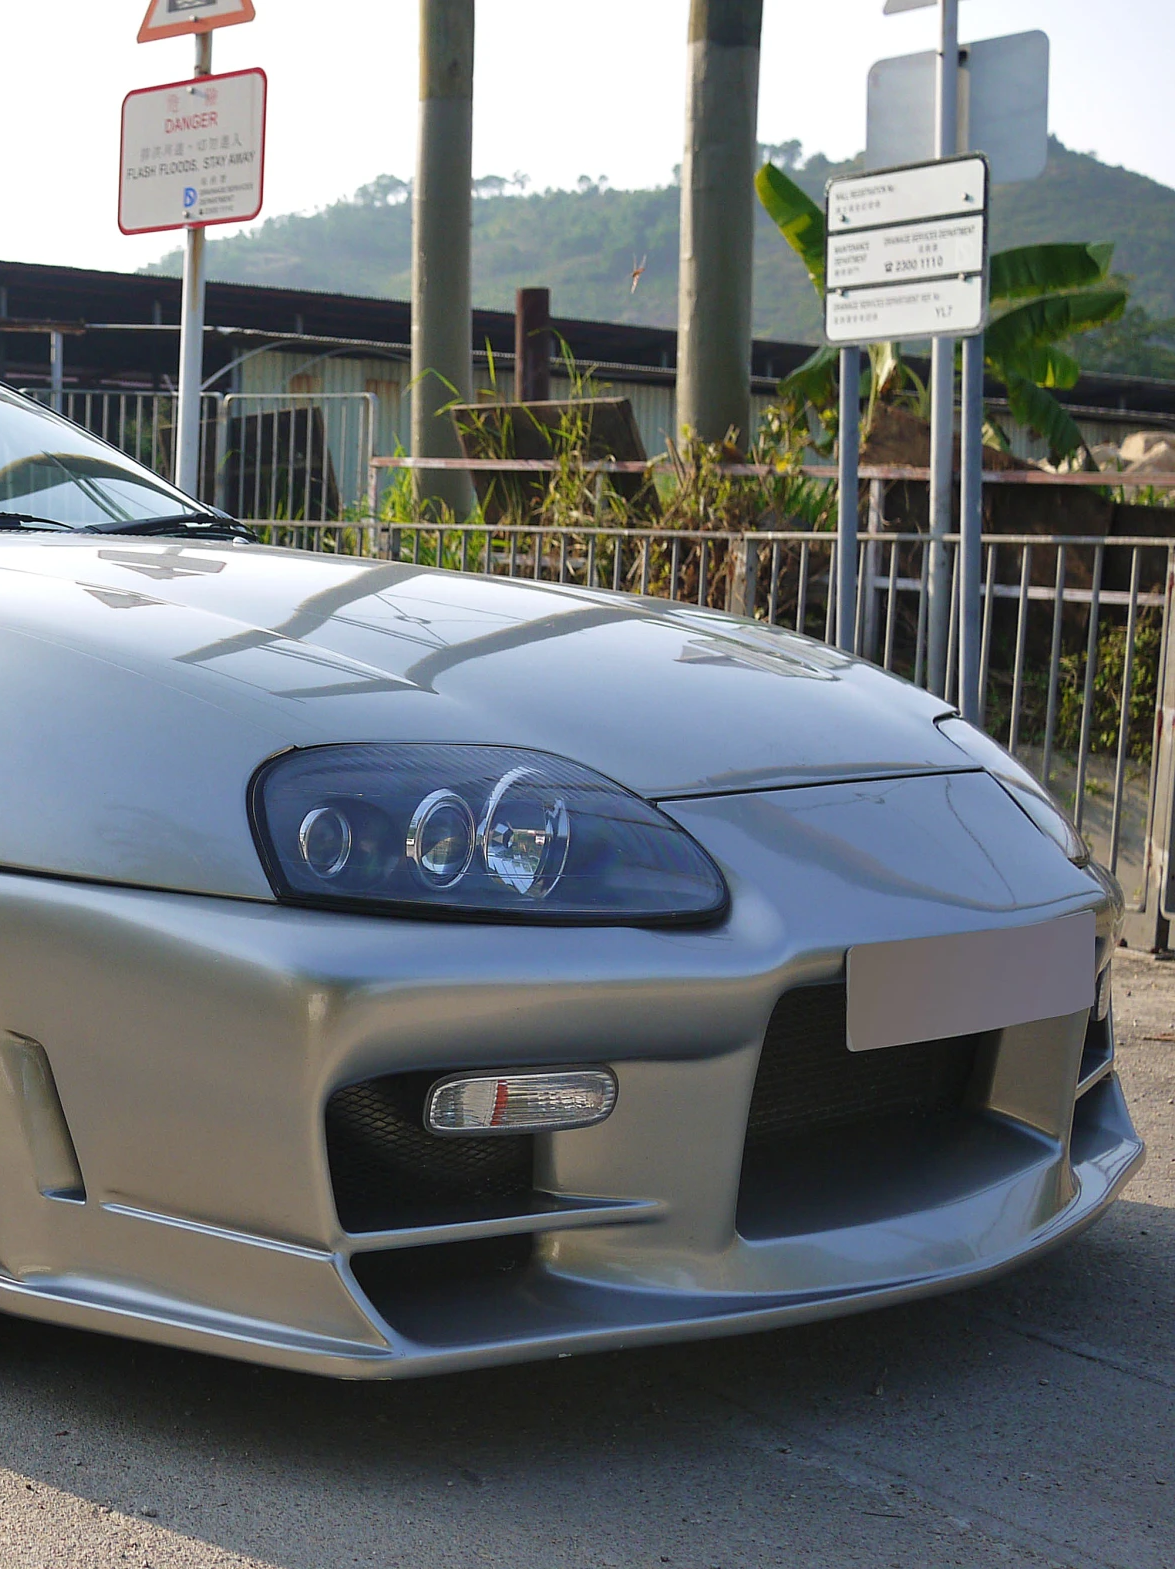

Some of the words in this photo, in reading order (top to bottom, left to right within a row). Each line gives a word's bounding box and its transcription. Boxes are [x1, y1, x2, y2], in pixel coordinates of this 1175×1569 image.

[164, 111, 219, 133] DANGER
[125, 165, 157, 180] FLASH
[202, 154, 228, 169] STAY
[229, 149, 256, 165] AWAY
[895, 258, 918, 273] 2300
[920, 255, 944, 269] 1110
[935, 305, 953, 319] YL7
